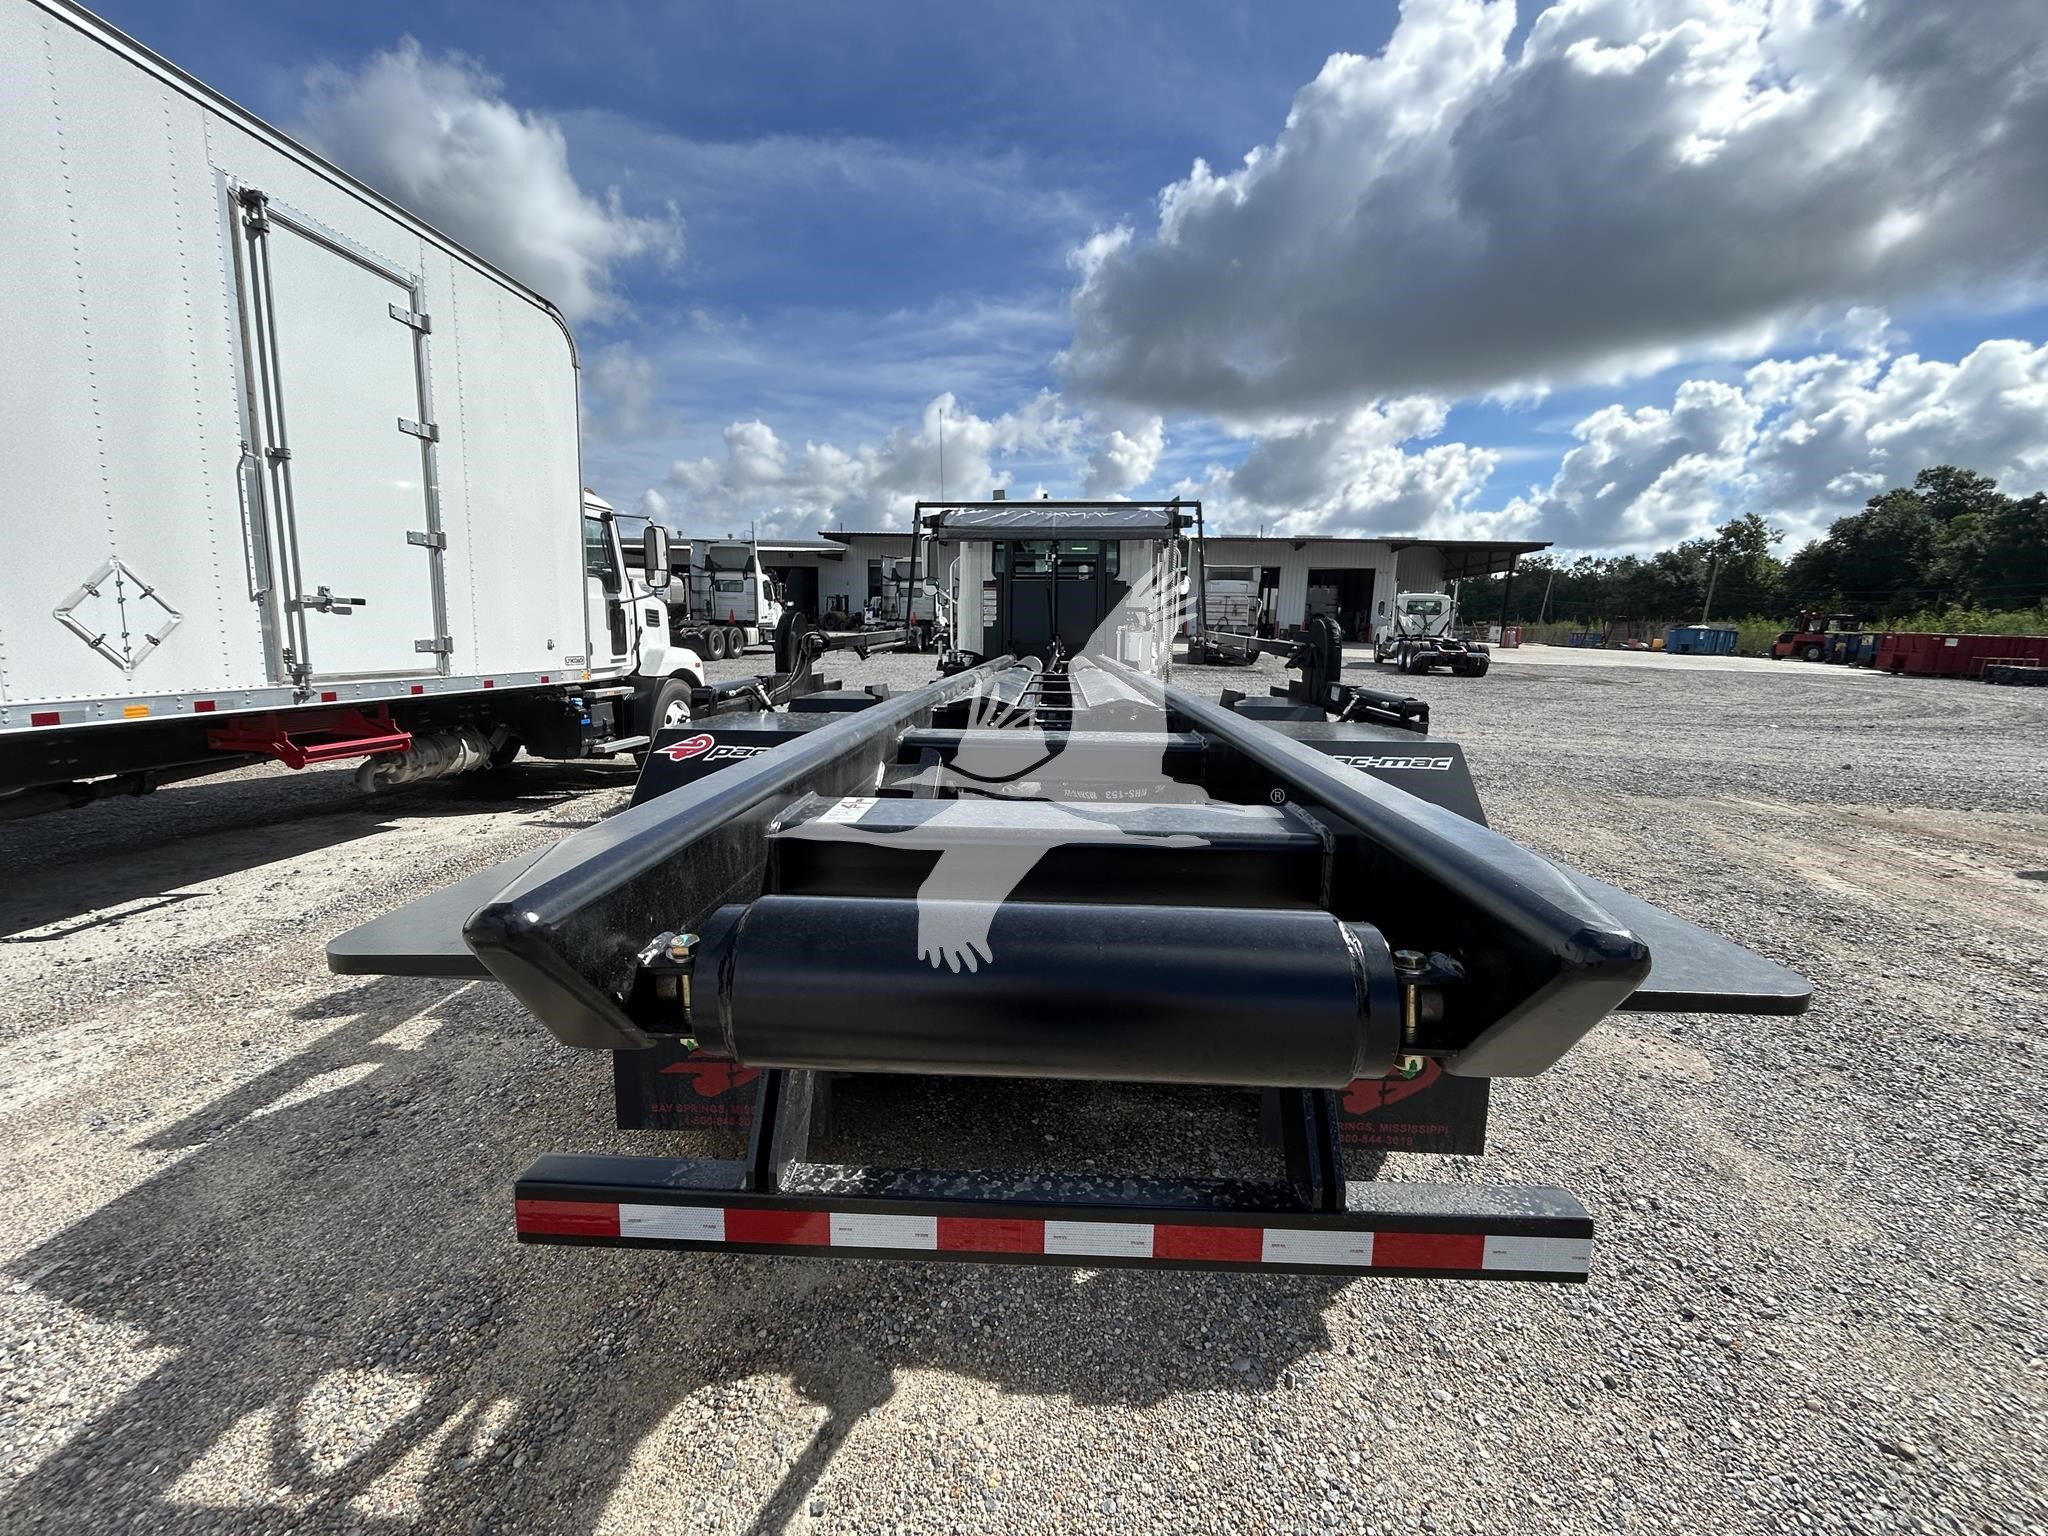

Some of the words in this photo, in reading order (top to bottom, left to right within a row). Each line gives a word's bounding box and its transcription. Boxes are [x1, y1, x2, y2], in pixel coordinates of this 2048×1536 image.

[1331, 756, 1453, 771] ac-mac
[651, 1103, 673, 1113] BAY
[1379, 1123, 1449, 1134] MISSISSIPPI
